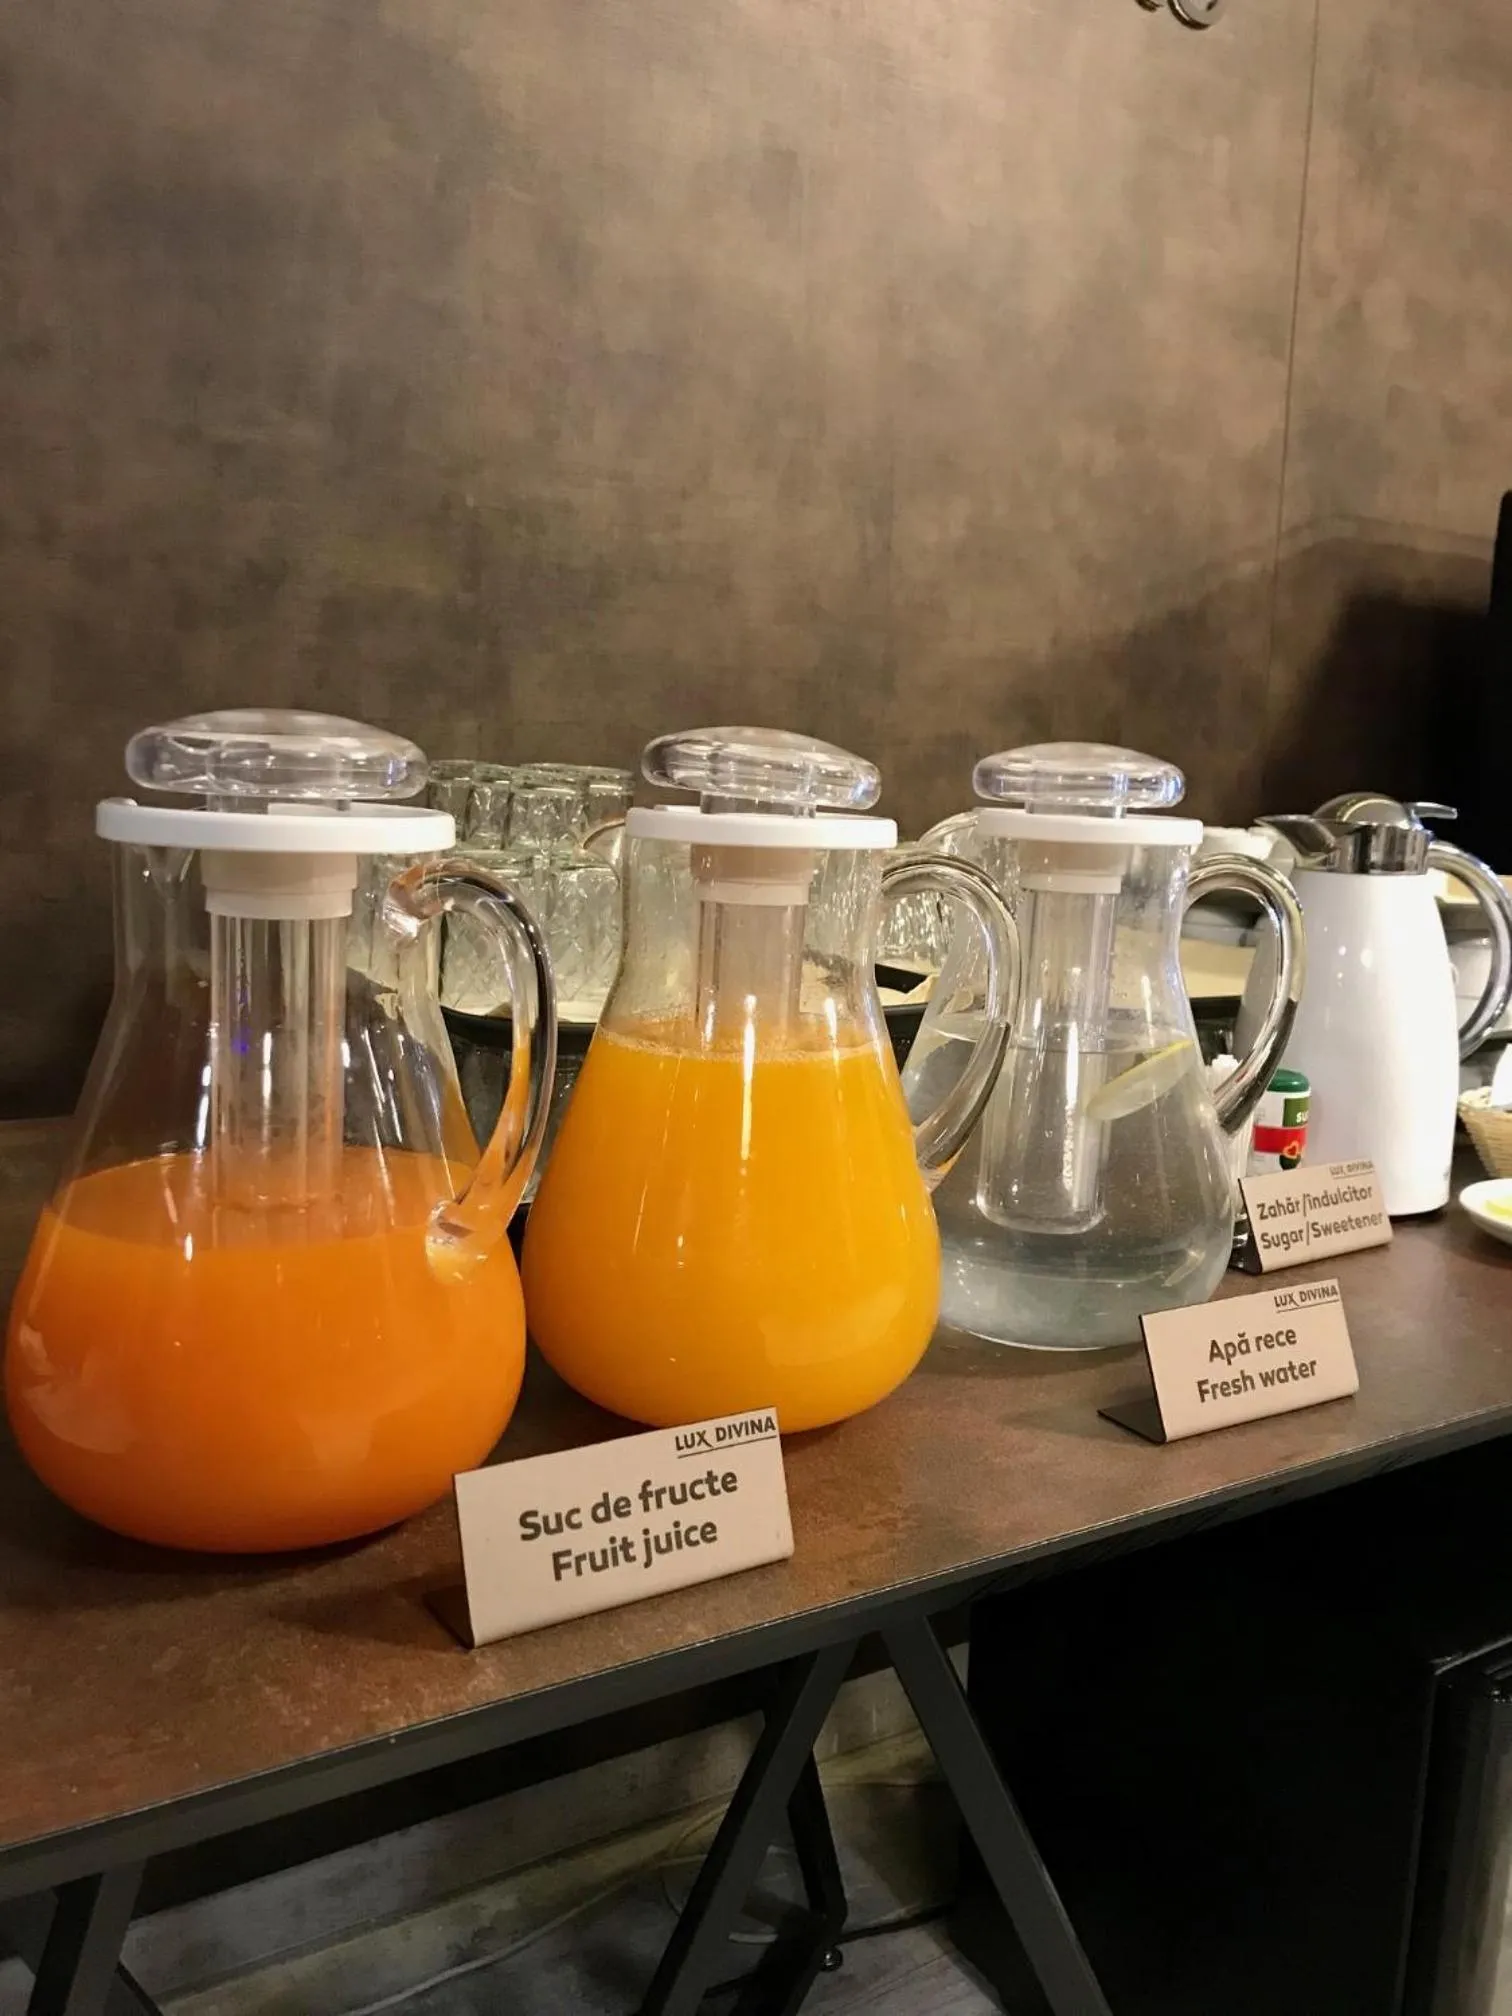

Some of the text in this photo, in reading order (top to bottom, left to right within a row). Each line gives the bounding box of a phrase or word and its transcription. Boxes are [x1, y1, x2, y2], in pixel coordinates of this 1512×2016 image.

[1260, 1212, 1383, 1251] Sugar/Sweetener
[1274, 1284, 1339, 1308] LUX DIVINA
[1208, 1328, 1298, 1366] Apă rece
[1197, 1359, 1318, 1404] Fresh water
[674, 1416, 777, 1451] LUX DIVINA
[518, 1469, 739, 1542] Suc de fructe
[552, 1520, 718, 1582] Fruit juice
